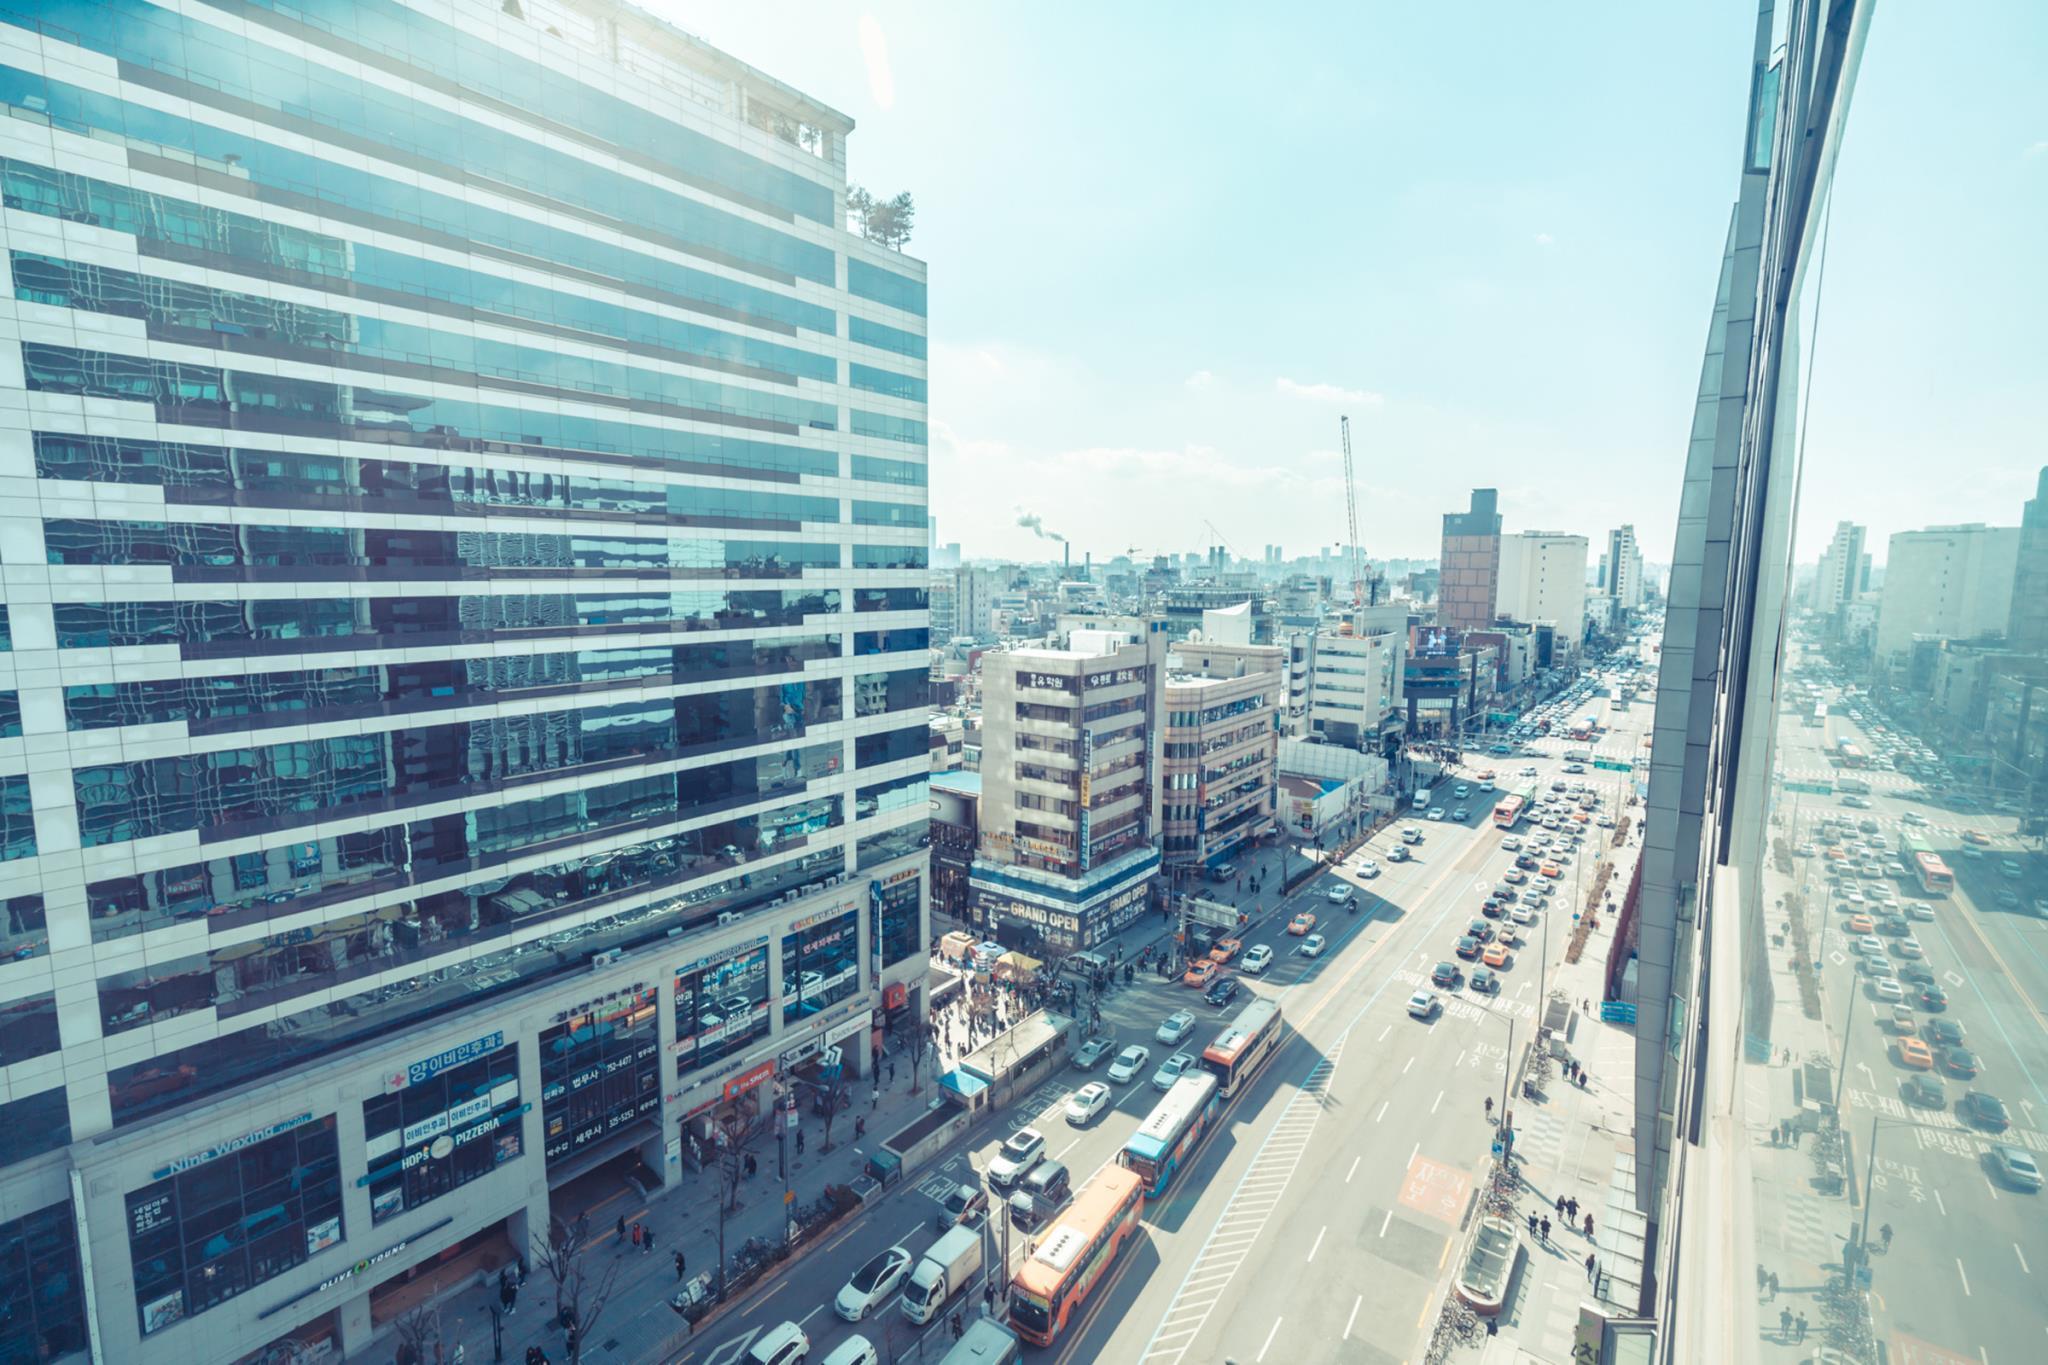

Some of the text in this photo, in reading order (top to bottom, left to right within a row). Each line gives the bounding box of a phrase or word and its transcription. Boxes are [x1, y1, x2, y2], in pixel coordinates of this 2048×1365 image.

[1110, 891, 1132, 913] GRAND
[1011, 902, 1047, 923] GRAND
[1049, 912, 1079, 932] OPEN
[451, 1099, 489, 1121] 이비인후과
[405, 1118, 447, 1141] 이비인후과
[455, 1118, 500, 1146] PIZZERIA
[169, 1126, 275, 1175] Nine Waxing
[320, 1242, 407, 1291] OLIVE YOUNG
